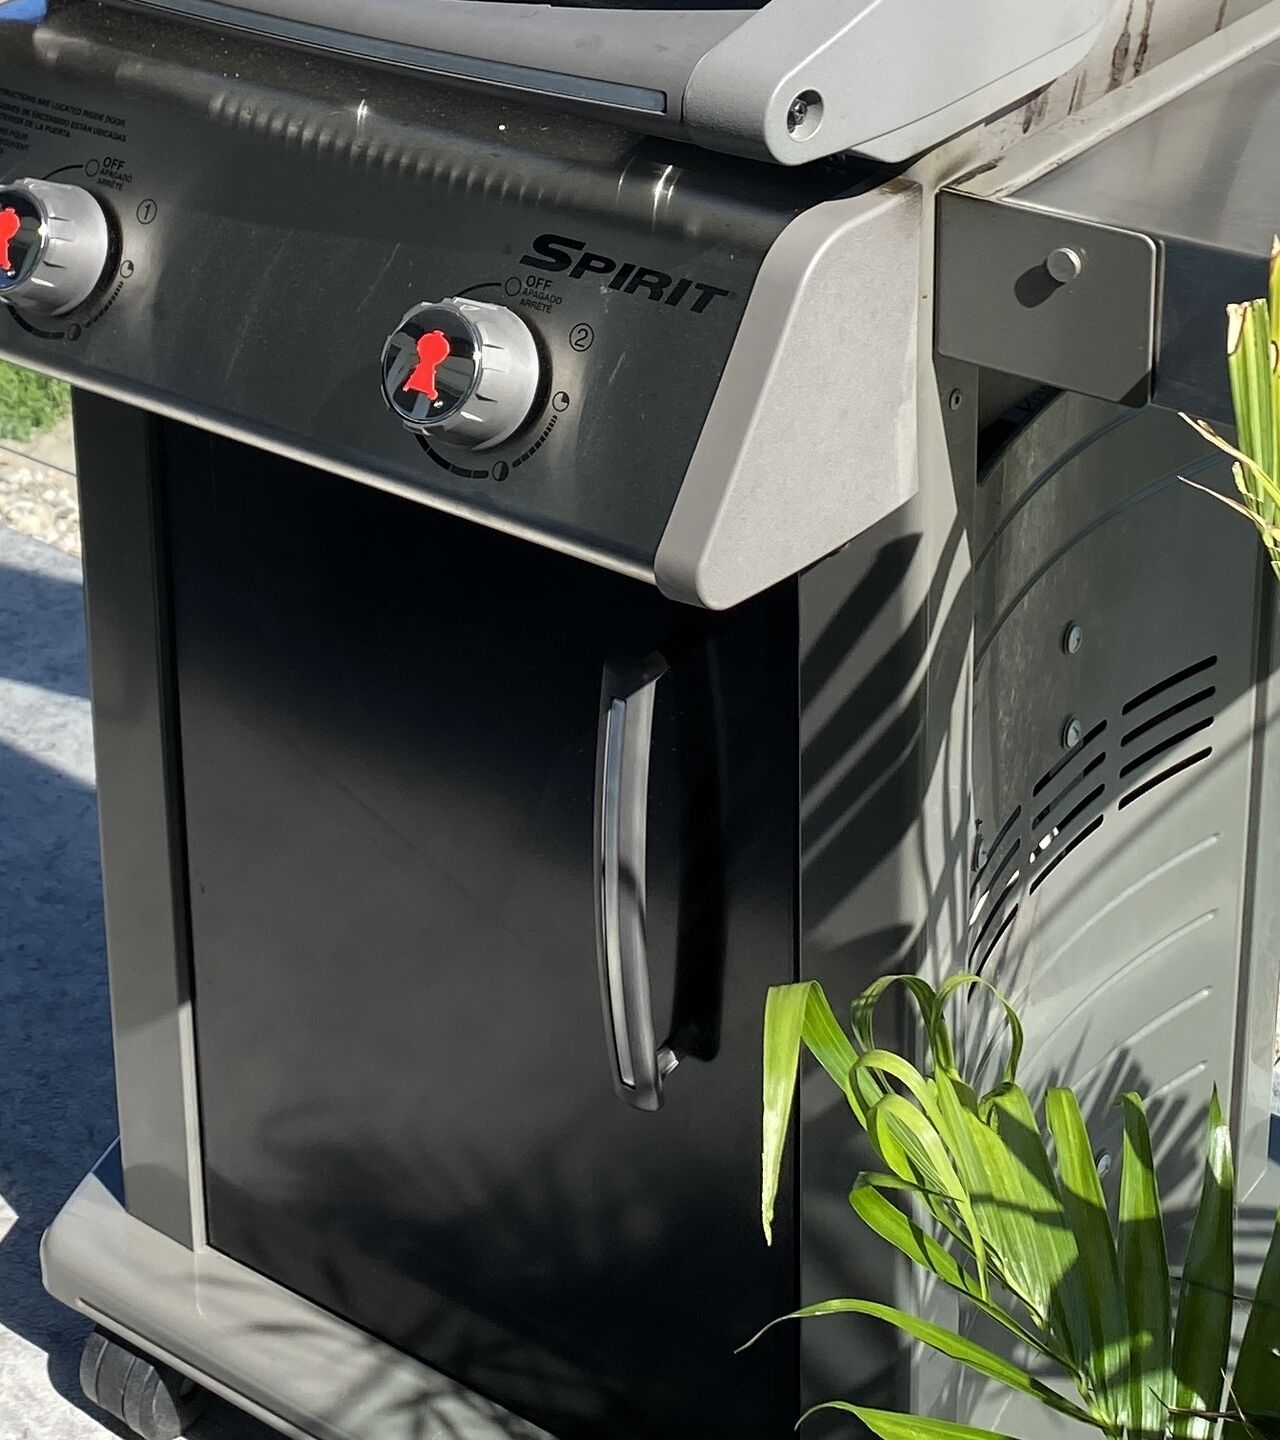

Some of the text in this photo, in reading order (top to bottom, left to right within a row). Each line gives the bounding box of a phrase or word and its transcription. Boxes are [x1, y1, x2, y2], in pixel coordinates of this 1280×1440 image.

[51, 101, 82, 116] LOCATED
[103, 156, 126, 171] OFF
[100, 167, 133, 184] APAGADO
[518, 233, 730, 314] SPIRIT
[526, 275, 554, 291] OFF
[522, 287, 562, 305] APAGADO
